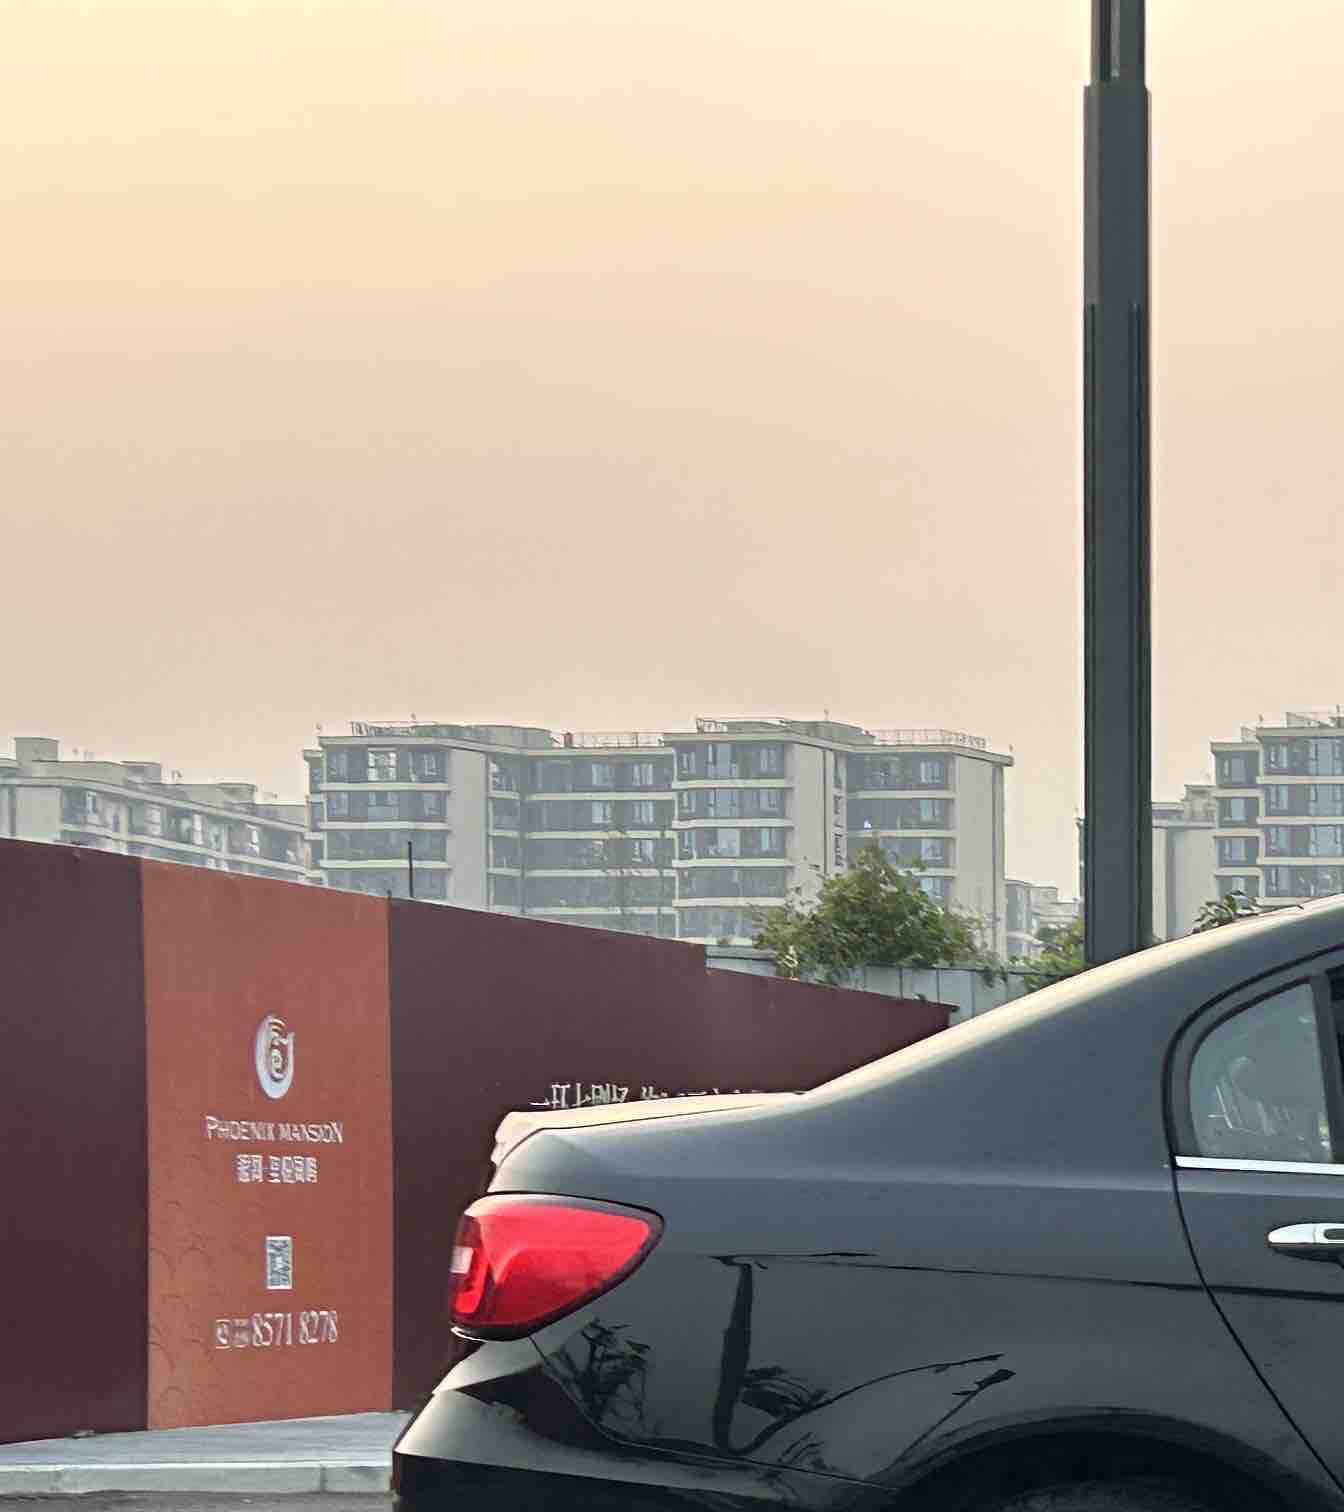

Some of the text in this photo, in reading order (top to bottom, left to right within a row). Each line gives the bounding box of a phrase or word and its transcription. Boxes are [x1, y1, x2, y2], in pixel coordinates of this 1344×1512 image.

[205, 1115, 343, 1144] PHOENIX MANSION
[252, 1312, 292, 1346] 8571
